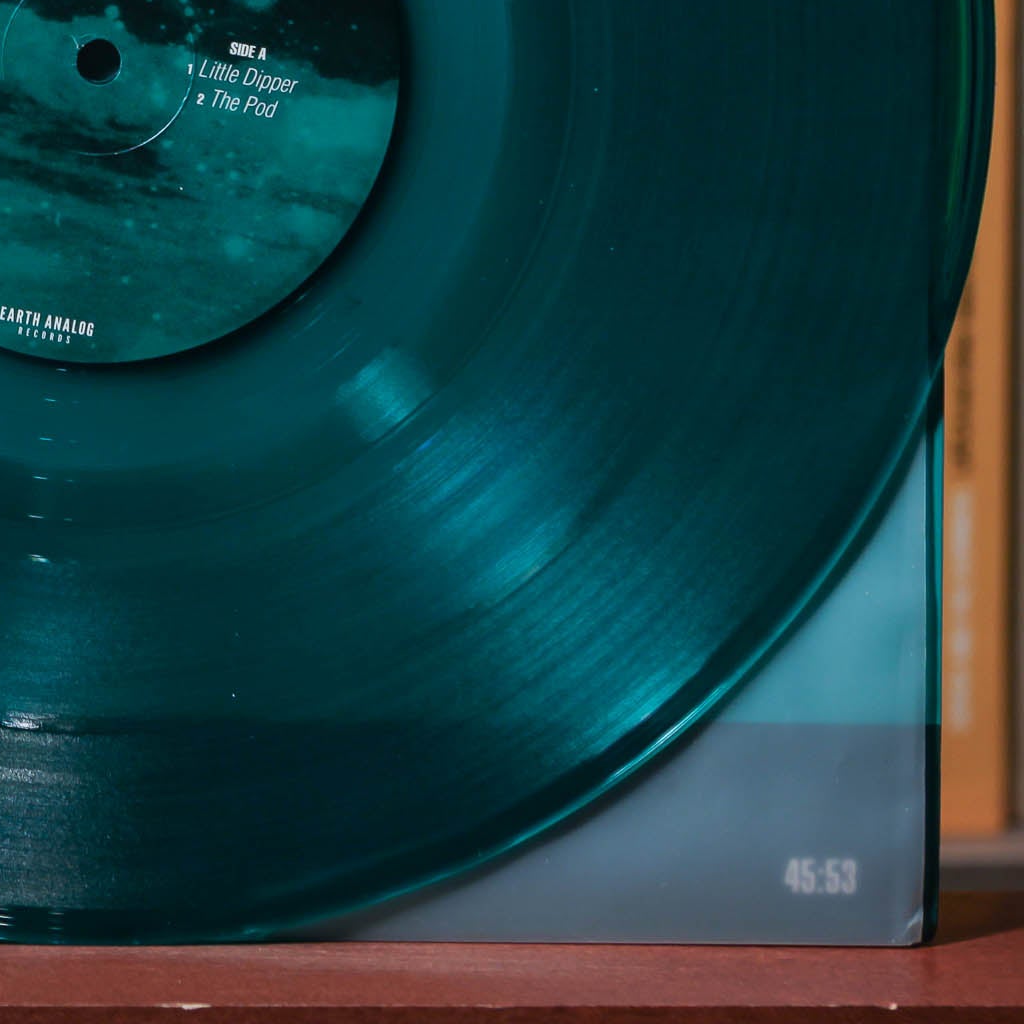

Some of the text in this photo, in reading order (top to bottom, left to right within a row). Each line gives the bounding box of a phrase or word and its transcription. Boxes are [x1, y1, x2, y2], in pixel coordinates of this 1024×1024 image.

[229, 41, 267, 61] SIDE A
[187, 59, 299, 94] 1 Little Dipper
[196, 89, 279, 118] 2 The Pod
[0, 305, 95, 337] EARTH ANALOG
[18, 326, 71, 344] RECORDS
[783, 857, 858, 895] 45:53
